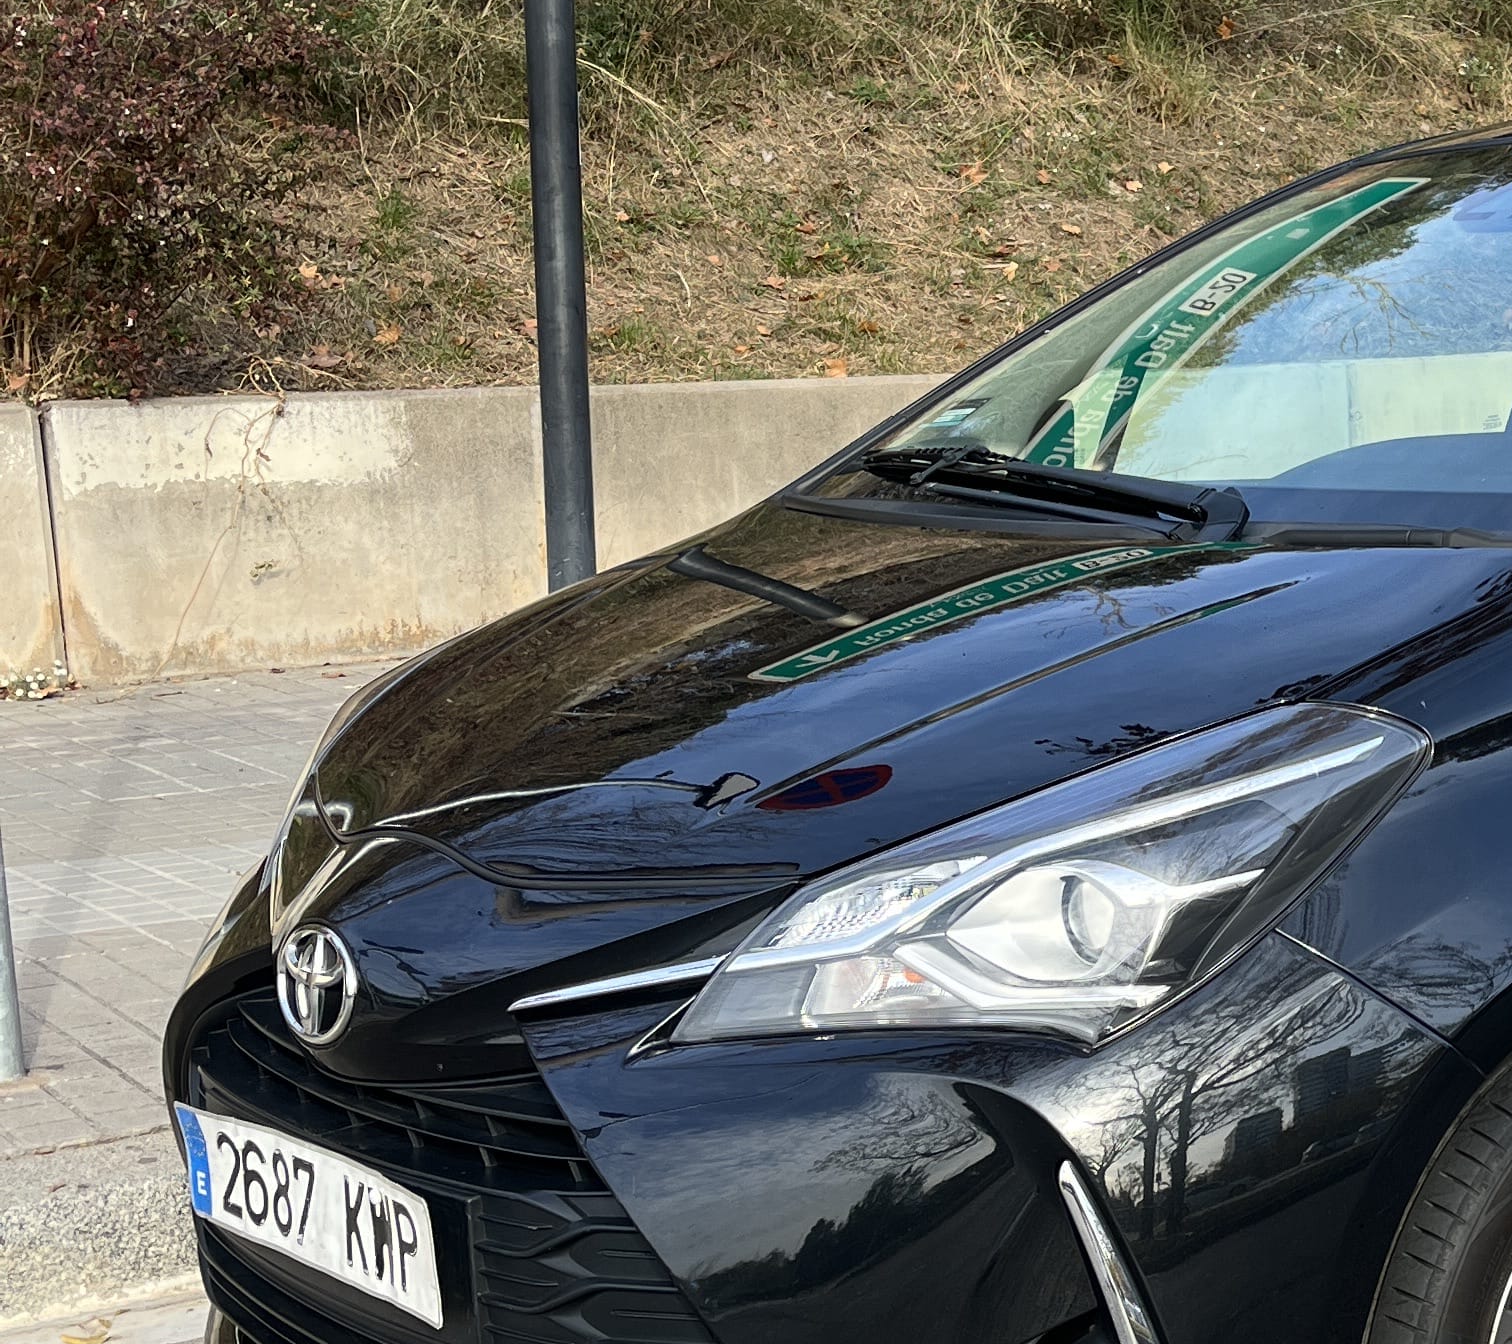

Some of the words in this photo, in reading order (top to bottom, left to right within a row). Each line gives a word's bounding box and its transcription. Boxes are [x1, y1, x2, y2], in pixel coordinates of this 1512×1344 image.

[196, 1170, 208, 1196] E
[217, 1130, 315, 1246] 2687
[343, 1174, 418, 1293] KWP
